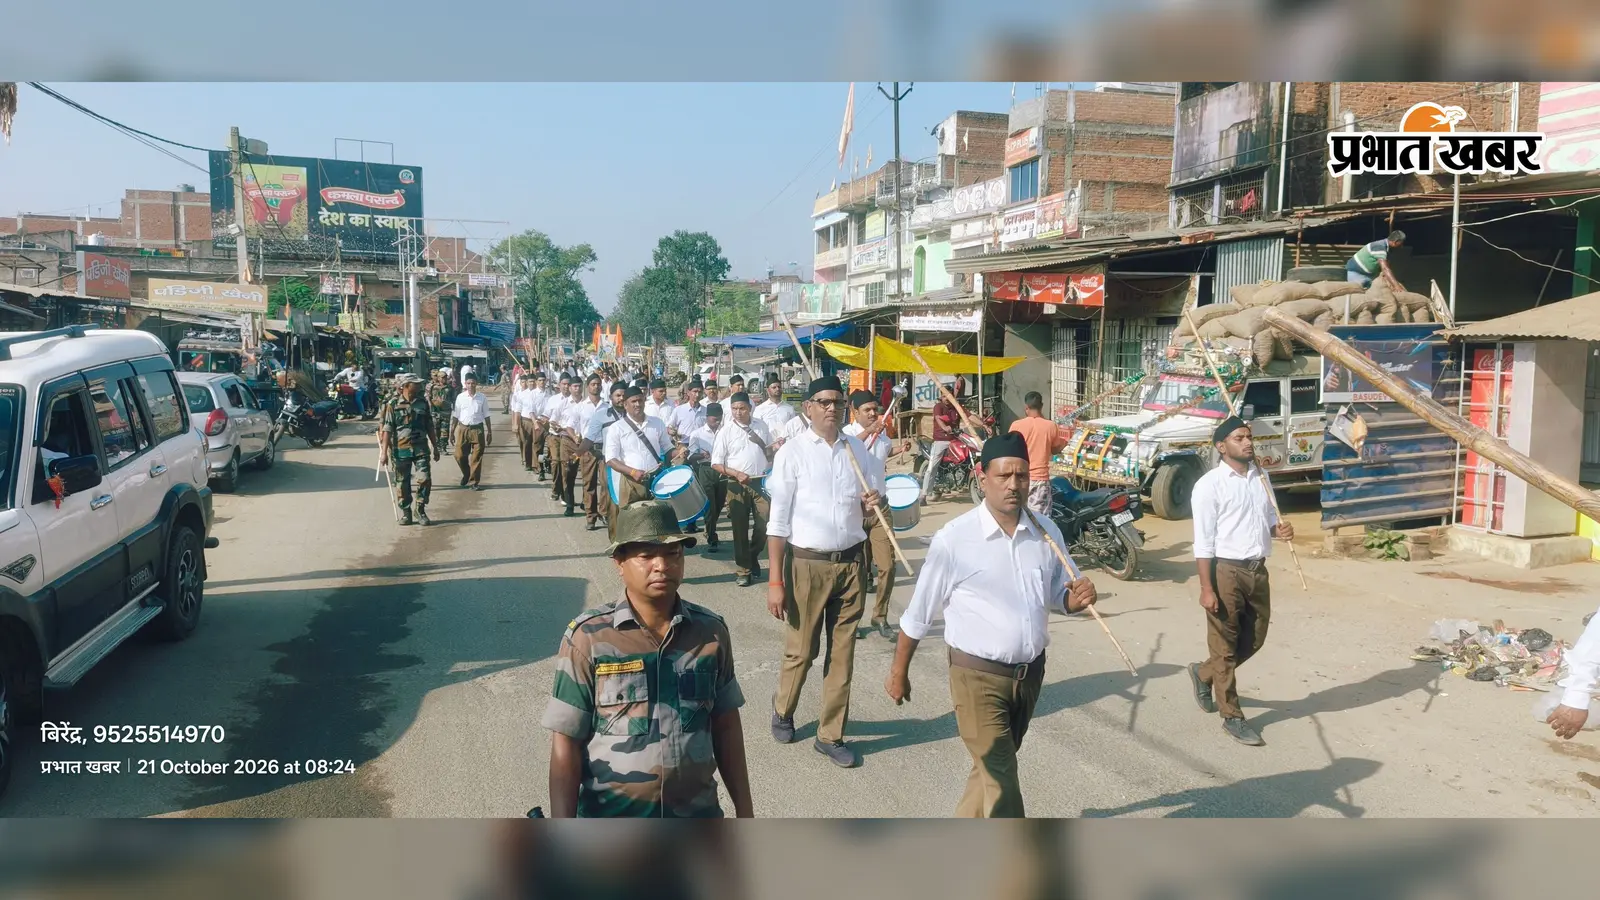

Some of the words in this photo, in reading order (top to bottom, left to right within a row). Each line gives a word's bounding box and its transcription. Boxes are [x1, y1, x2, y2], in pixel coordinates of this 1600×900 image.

[249, 189, 273, 197] कमला
[327, 190, 363, 203] कमला
[318, 207, 345, 226] देश
[349, 212, 372, 227] का
[374, 215, 408, 230] स्वाद
[1080, 276, 1099, 288] Coca-Cola
